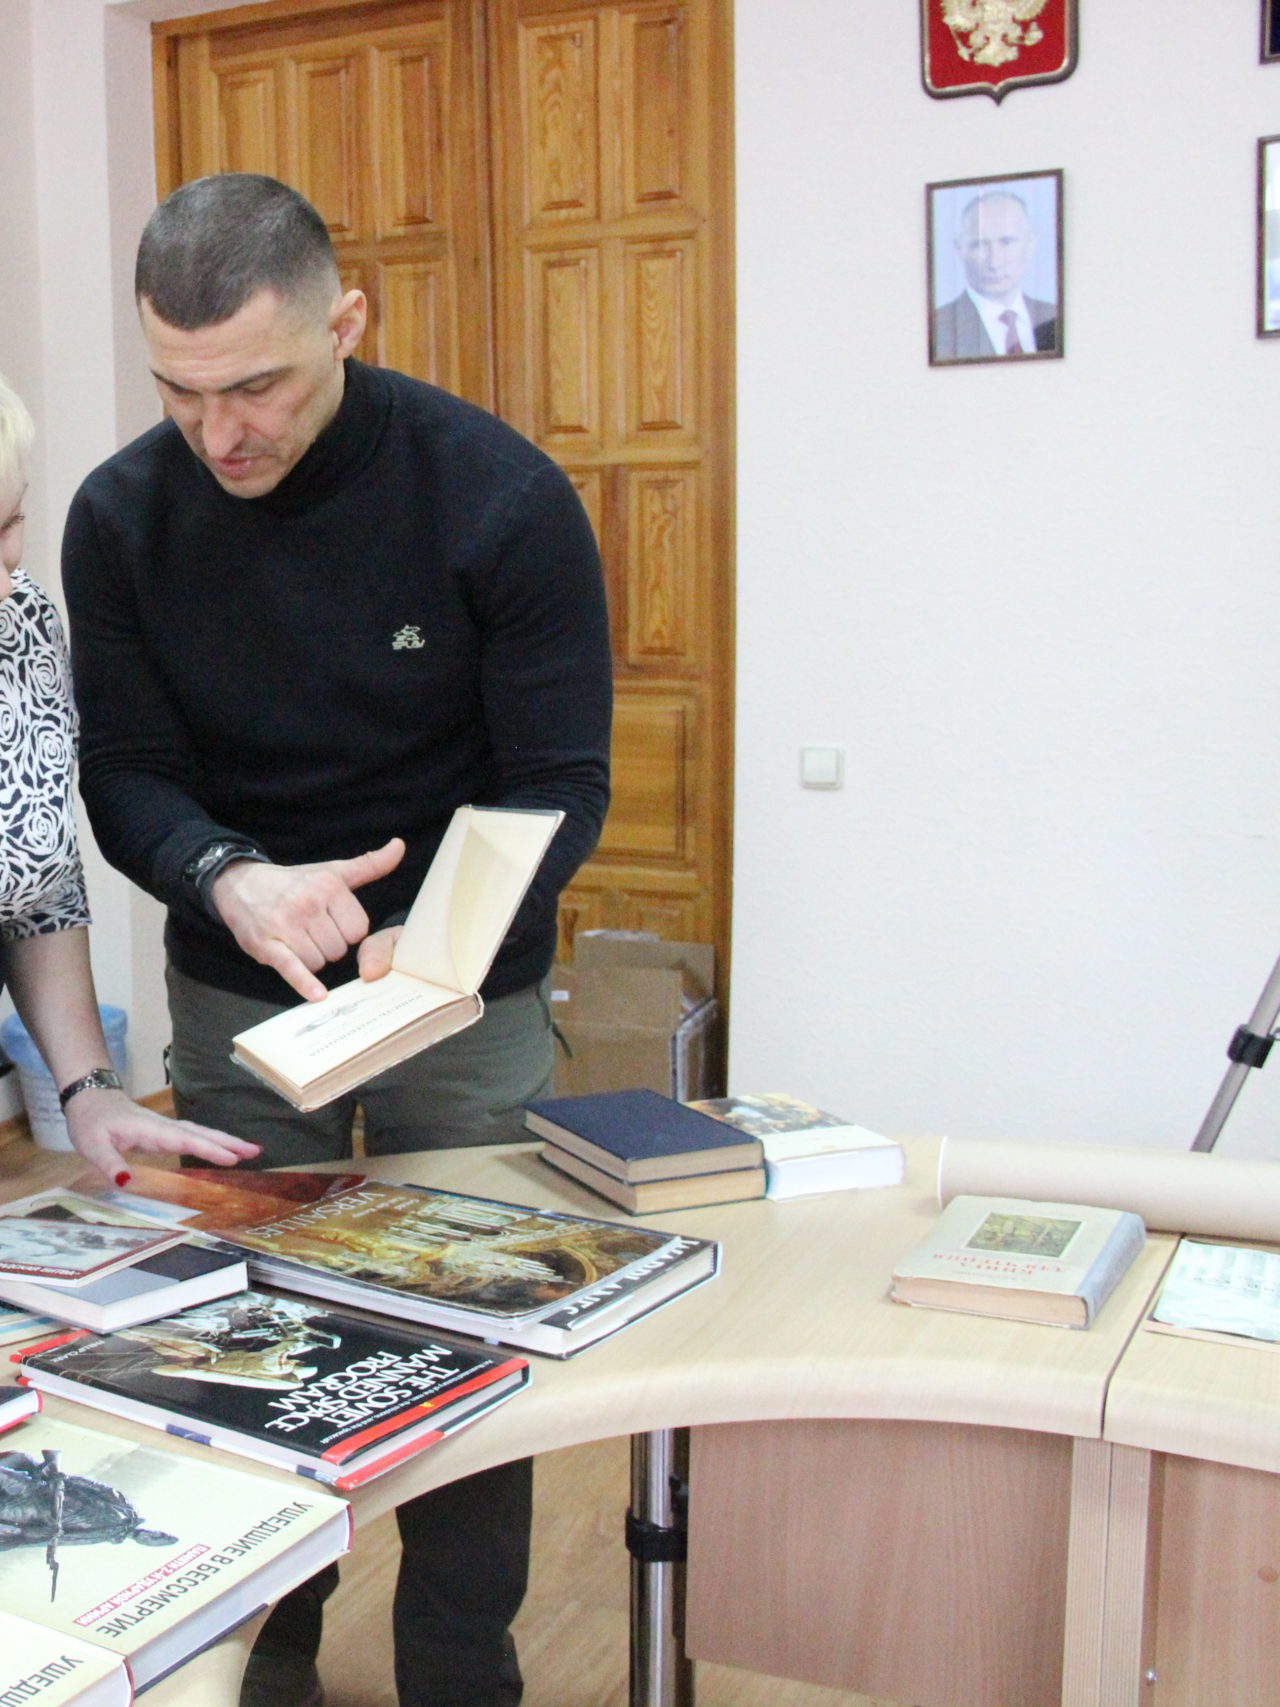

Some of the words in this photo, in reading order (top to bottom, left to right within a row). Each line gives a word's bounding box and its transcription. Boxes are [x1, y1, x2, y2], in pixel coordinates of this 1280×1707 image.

[245, 1191, 387, 1239] VERSAILLES
[267, 1350, 402, 1411] PROGRAM
[338, 1344, 453, 1400] MANNED
[398, 1365, 460, 1390] THE
[264, 1395, 349, 1432] SPACE
[322, 1385, 412, 1428] SOVIET
[222, 1501, 314, 1557] УШЕДШИЕ
[210, 1554, 234, 1565] В
[96, 1562, 221, 1638] БЕССМЕРТИЕ
[110, 1574, 156, 1606] УДАРНОЙ
[75, 1599, 117, 1627] АРМИИ
